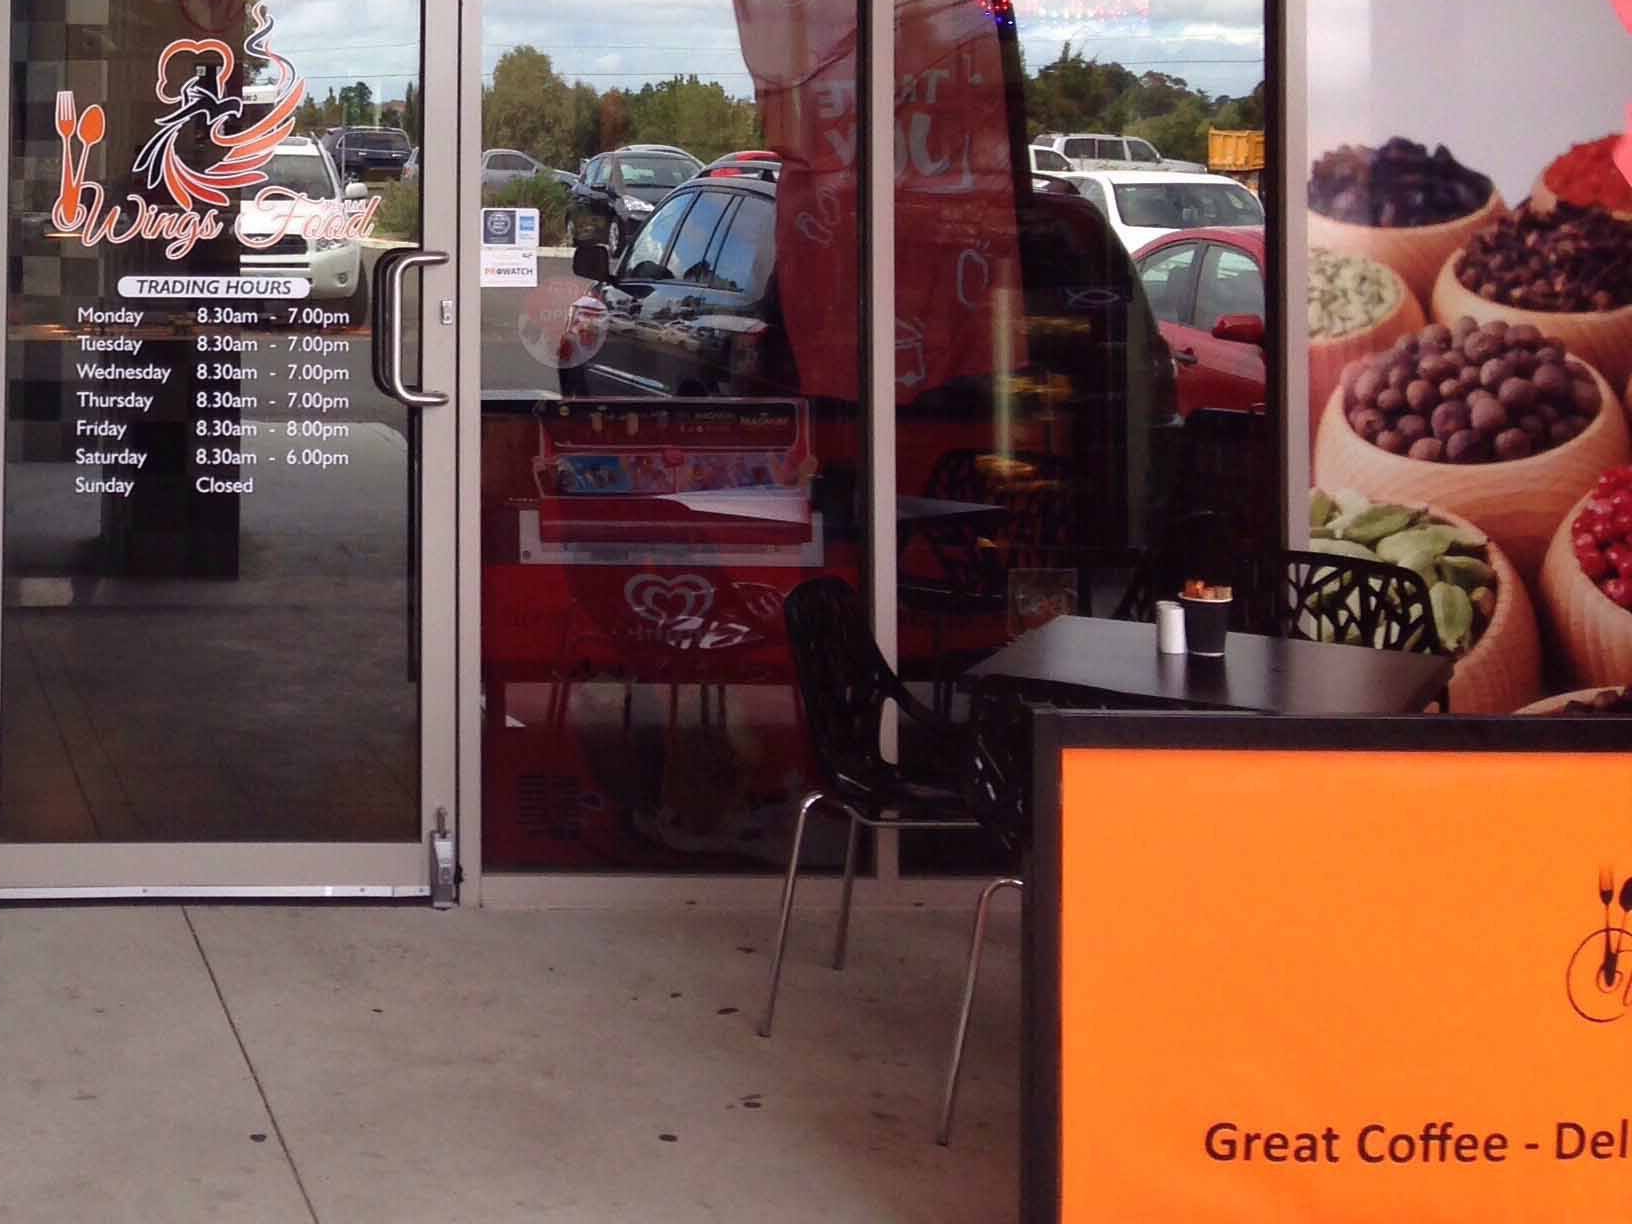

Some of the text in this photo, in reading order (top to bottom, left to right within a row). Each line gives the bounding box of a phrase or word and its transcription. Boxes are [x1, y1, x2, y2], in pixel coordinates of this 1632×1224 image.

[52, 180, 382, 261] Wings Food
[137, 279, 293, 296] TRADING HOURS
[77, 307, 144, 327] Monday
[196, 308, 258, 323] 8.30am
[286, 308, 350, 328] 7.00pm
[77, 335, 143, 355] Tuesday
[196, 336, 258, 351] 8.30am
[286, 336, 350, 356] 7.00pm
[76, 364, 171, 384] Wednesday
[196, 364, 258, 380] 8.30am
[286, 365, 350, 384] 7.00pm
[76, 392, 153, 412] Thursday
[196, 392, 258, 408] 8.30am
[286, 393, 350, 412] 7.00pm
[76, 420, 127, 440] Friday
[196, 421, 258, 436] 8.30am
[286, 421, 350, 441] 8.00pm
[75, 448, 147, 468] Saturday
[196, 449, 258, 464] 8.30am
[286, 450, 350, 469] 6.00pm
[75, 477, 254, 497] Sunday Closed
[1204, 1121, 1340, 1162] Great
[1357, 1121, 1508, 1163] Coffee
